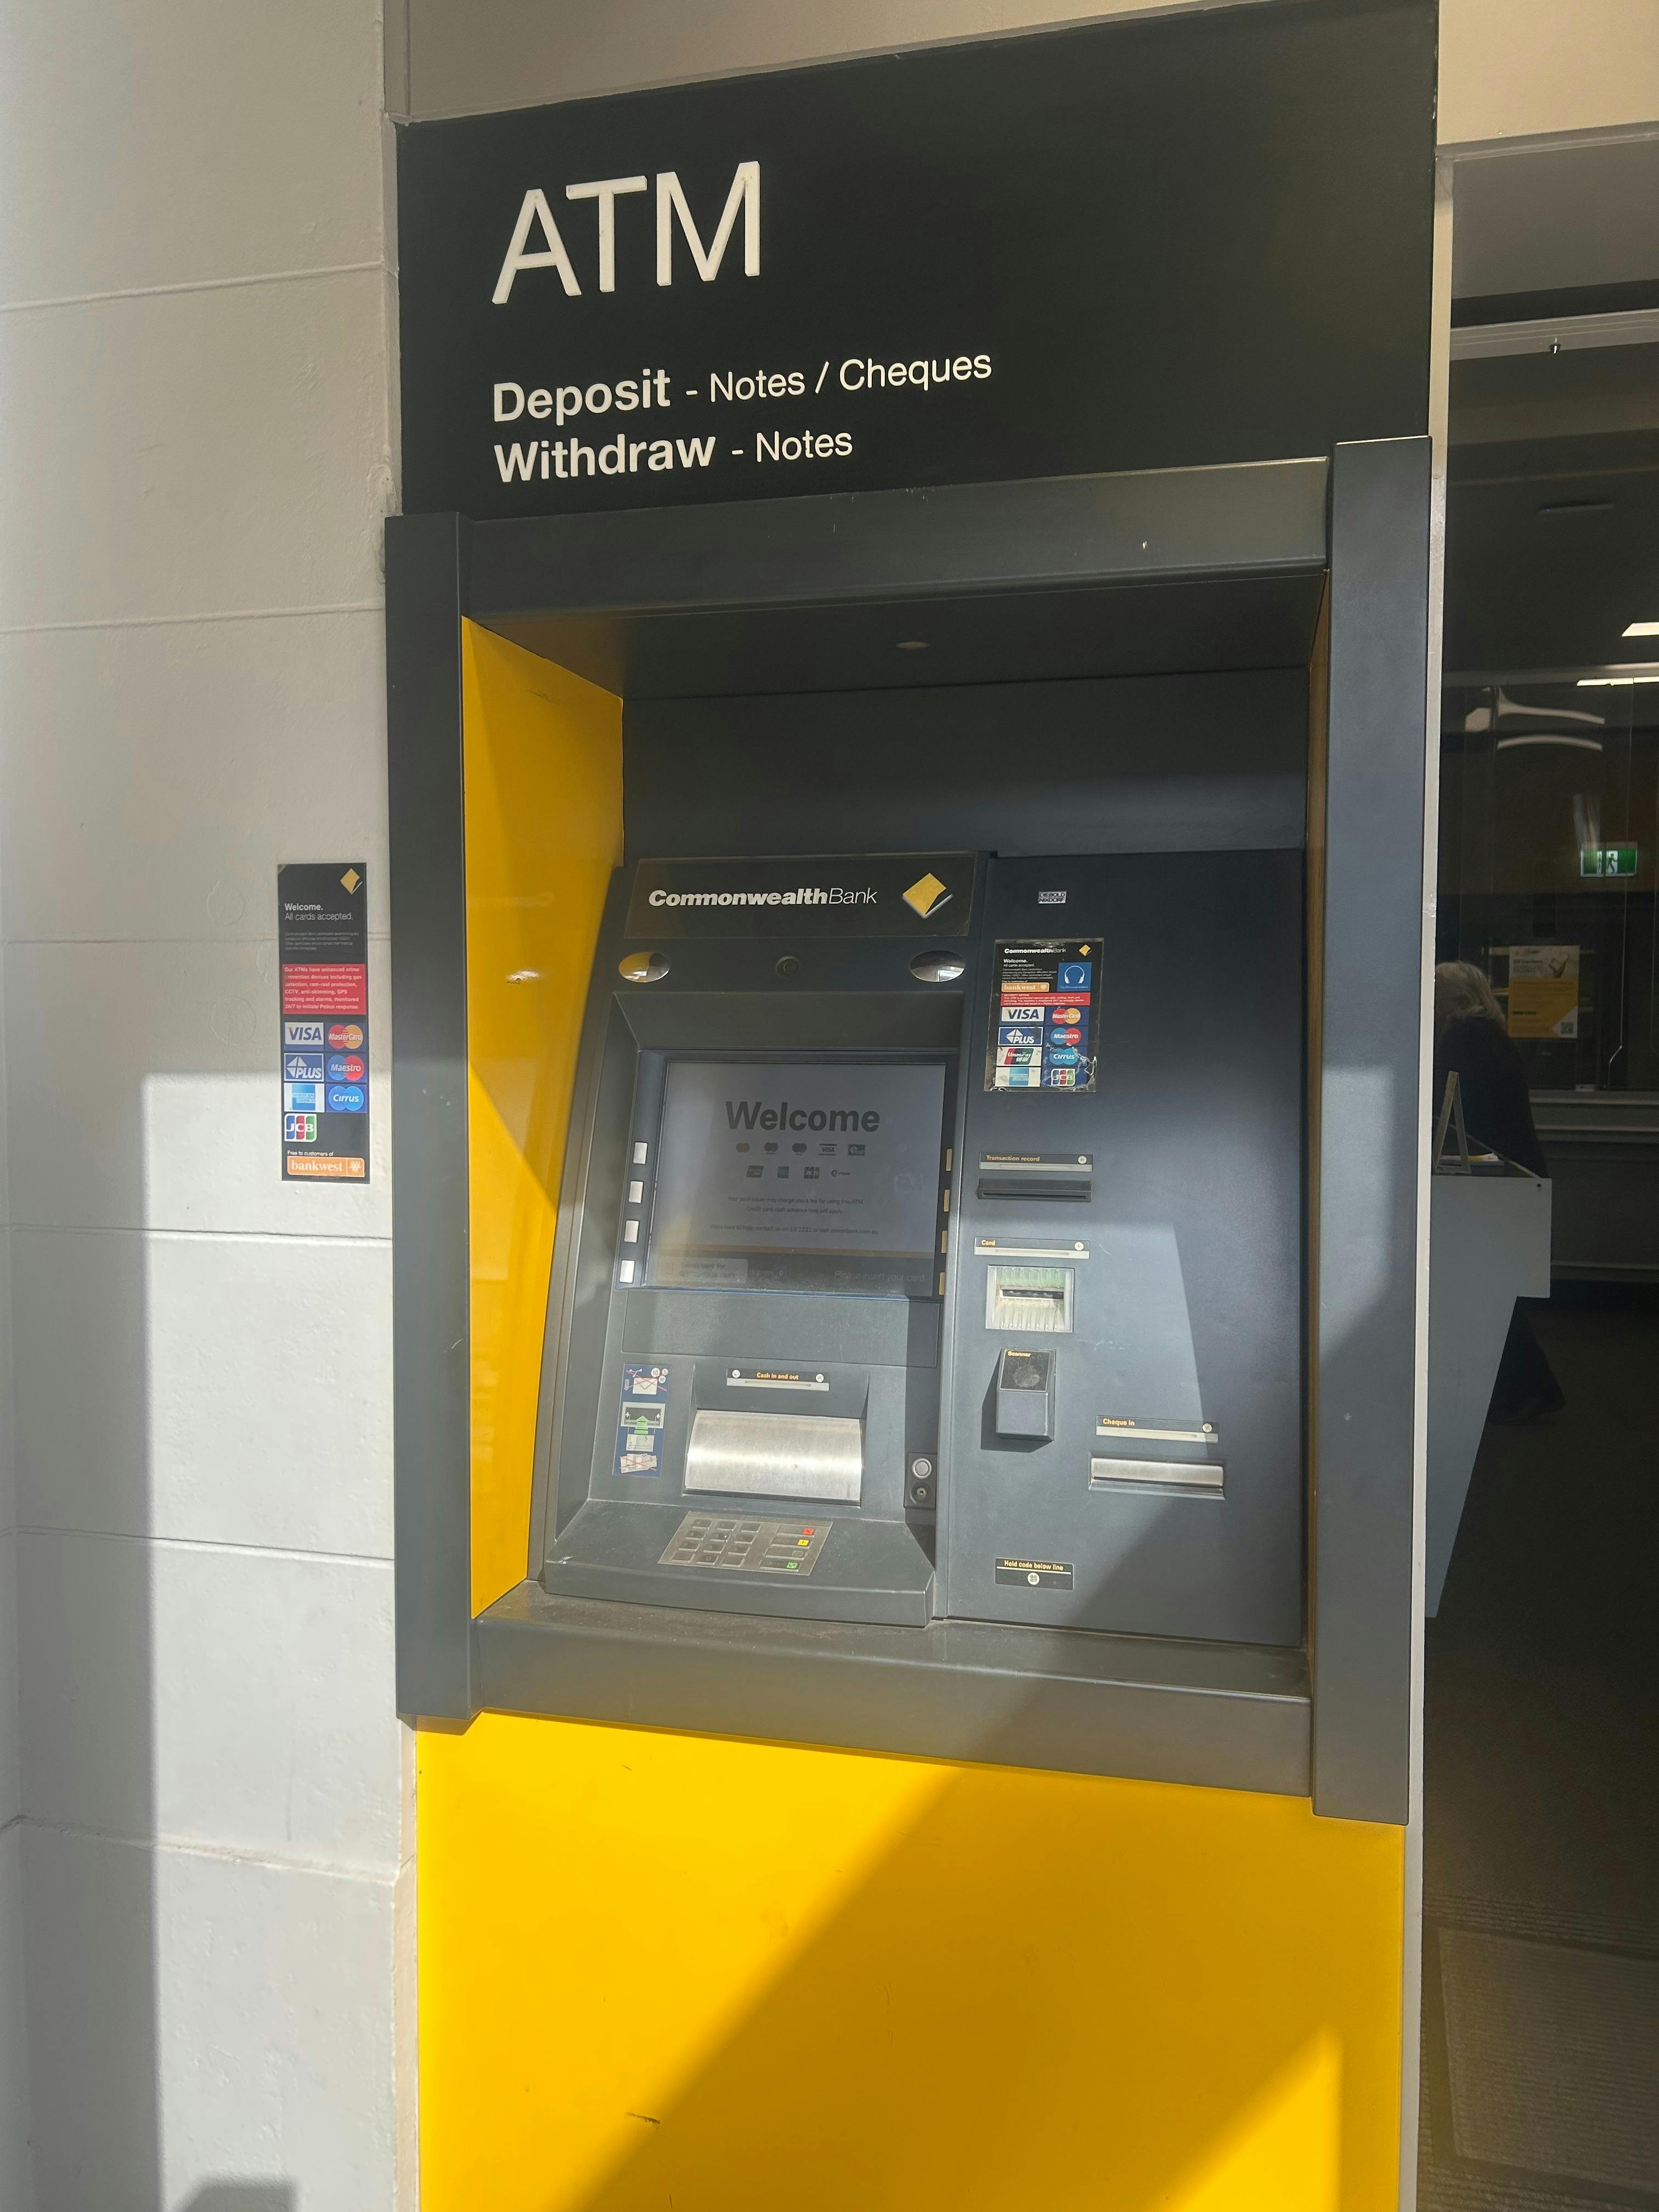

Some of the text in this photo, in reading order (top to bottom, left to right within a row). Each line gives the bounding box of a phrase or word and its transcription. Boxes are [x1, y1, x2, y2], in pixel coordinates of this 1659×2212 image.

[492, 161, 760, 304] ATM
[494, 368, 672, 426] Deposit
[710, 369, 806, 403] Notes
[815, 360, 830, 394] /
[839, 353, 992, 392] Cheques
[494, 433, 716, 483] Withdraw
[756, 430, 854, 462] Notes
[648, 887, 878, 907] CommonwealthBank
[284, 902, 324, 911] Welcome.
[284, 912, 354, 922] All cards accepted.
[1007, 1009, 1039, 1019] VISA
[287, 1026, 322, 1041] VISA
[329, 1032, 363, 1041] MasterCard
[1013, 1036, 1035, 1044] PLUS
[295, 1067, 322, 1079] PLUS
[330, 1064, 362, 1072] Maestro
[332, 1094, 360, 1103] Cirrus
[725, 1101, 881, 1132] Welcome
[285, 1123, 314, 1132] JCB
[291, 1159, 343, 1172] bankwest
[834, 1270, 860, 1280] Please
[887, 1273, 904, 1284] your
[1103, 1418, 1127, 1426] Cheque
